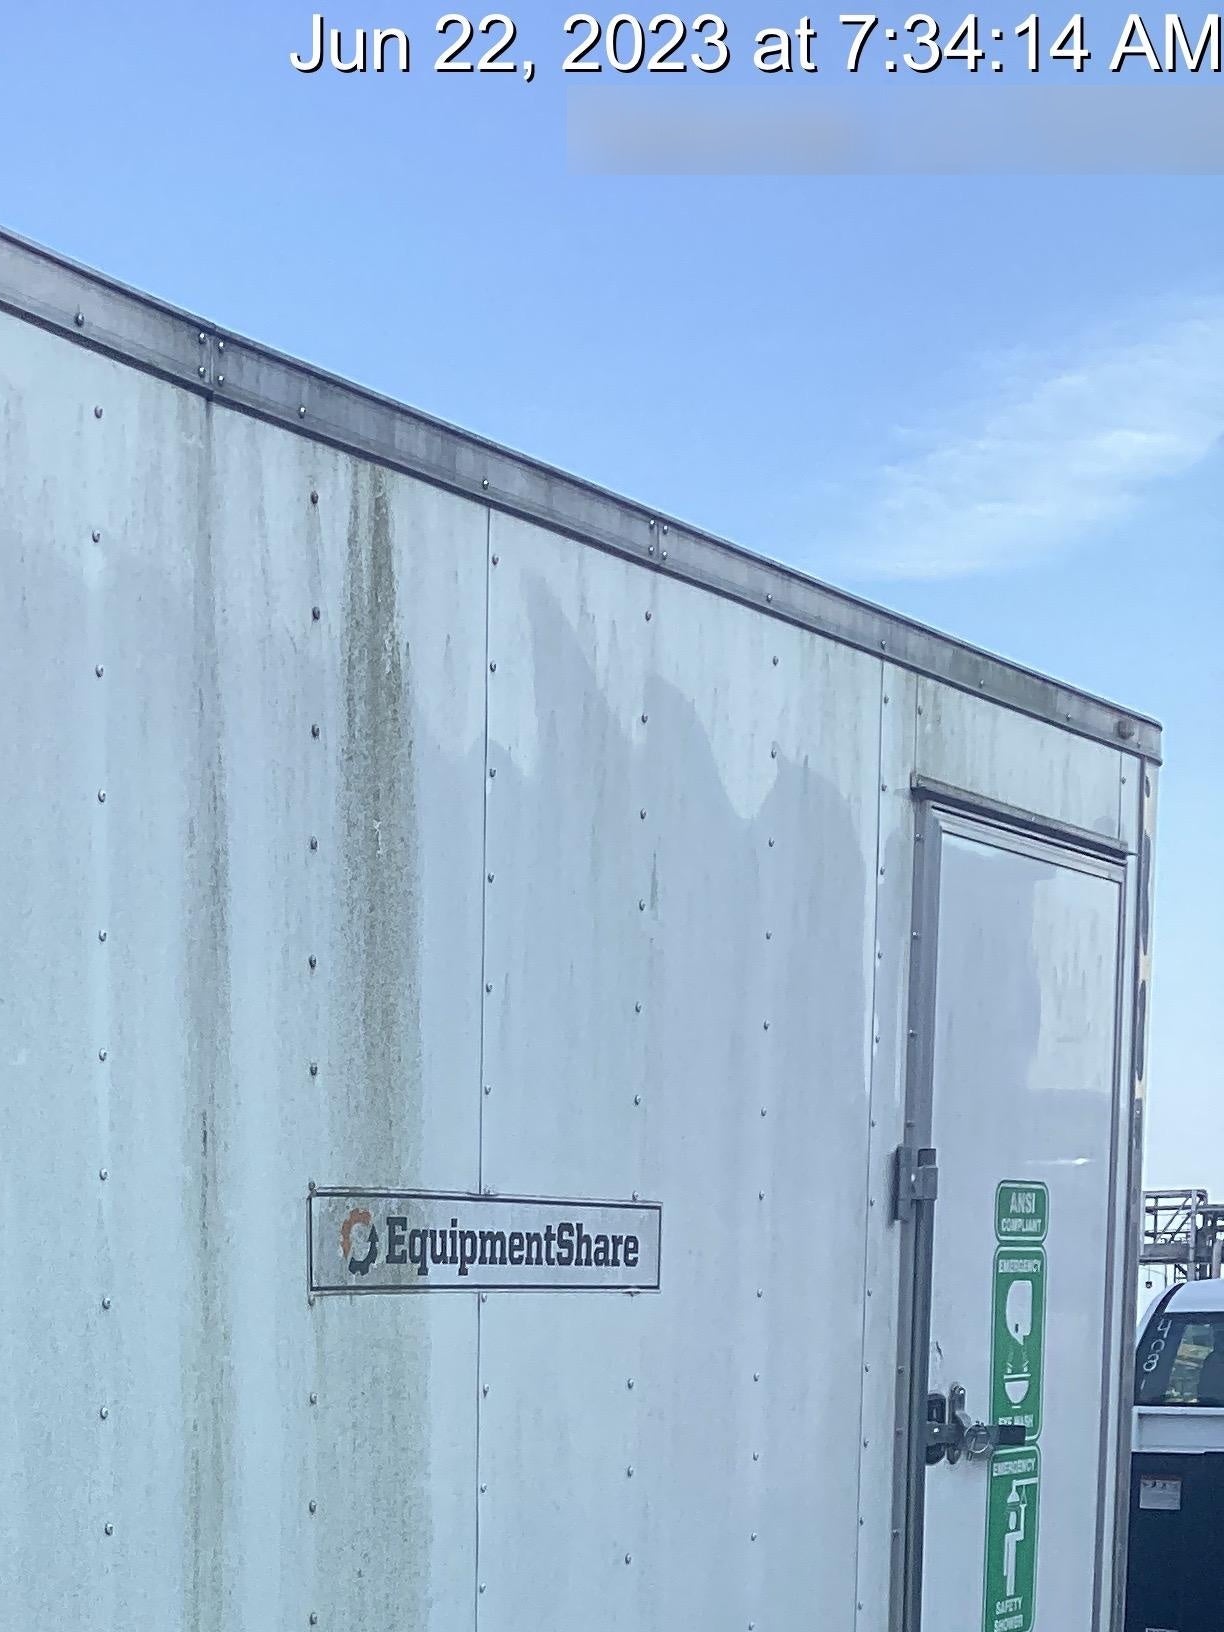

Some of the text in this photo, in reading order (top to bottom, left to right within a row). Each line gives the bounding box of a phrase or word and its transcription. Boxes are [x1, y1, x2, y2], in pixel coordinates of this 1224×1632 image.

[1009, 1192, 1036, 1214] ANSI
[1001, 1217, 1042, 1233] COMPLIANT
[384, 1216, 640, 1277] EquipmentShare
[995, 1596, 1024, 1615] SAFETY
